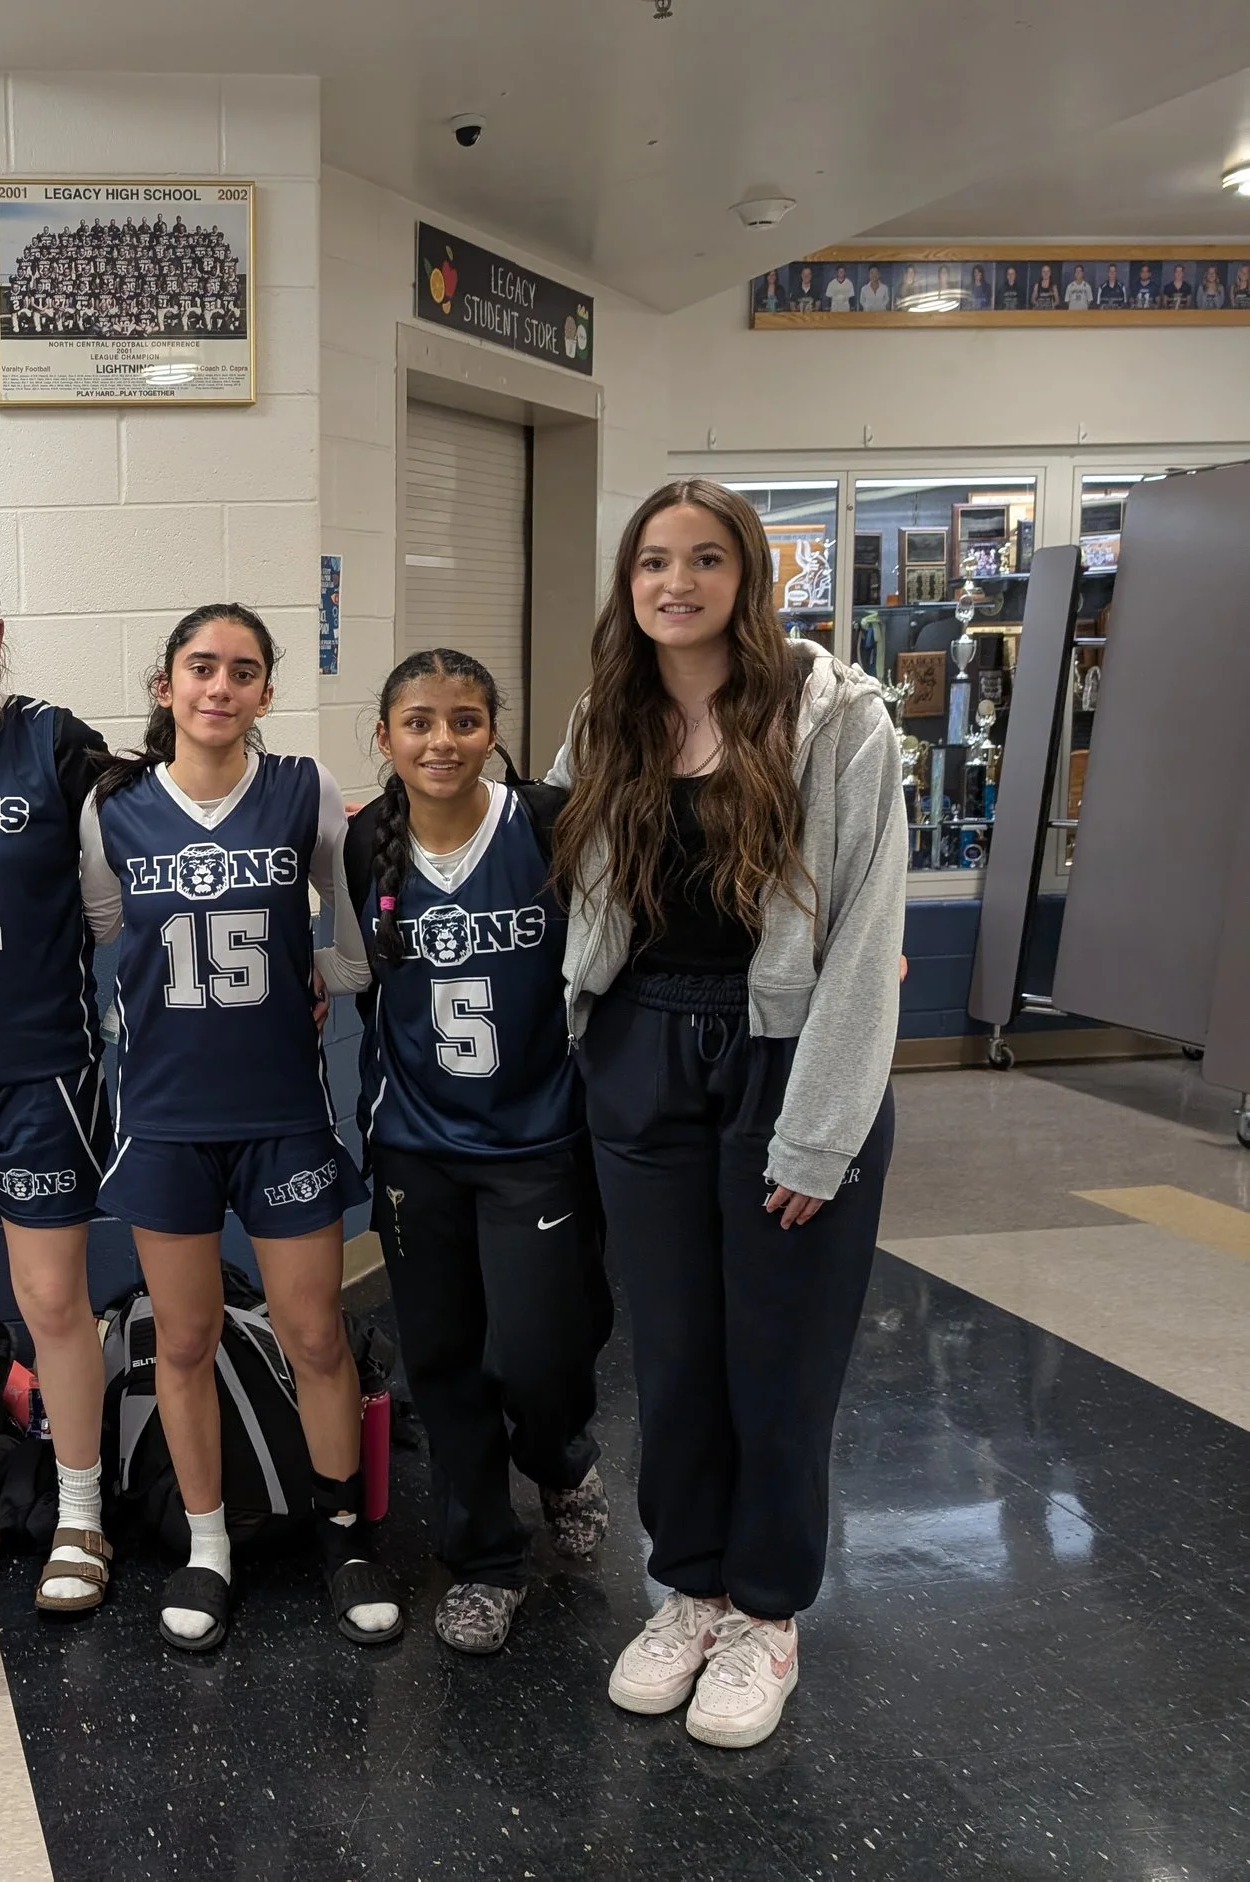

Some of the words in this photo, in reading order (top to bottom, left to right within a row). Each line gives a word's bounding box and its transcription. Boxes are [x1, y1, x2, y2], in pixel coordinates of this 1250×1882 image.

[44, 188, 101, 200] LEGACY
[105, 188, 140, 200] HIGH
[143, 189, 202, 201] SCHOOL
[217, 189, 248, 201] 2002
[491, 264, 536, 310] LEGACY
[463, 293, 519, 340] STUDENT
[524, 317, 560, 355] STORE
[1, 366, 24, 374] Varsity
[160, 908, 270, 1009] 15
[372, 904, 546, 967] IONS
[430, 976, 500, 1078] 5
